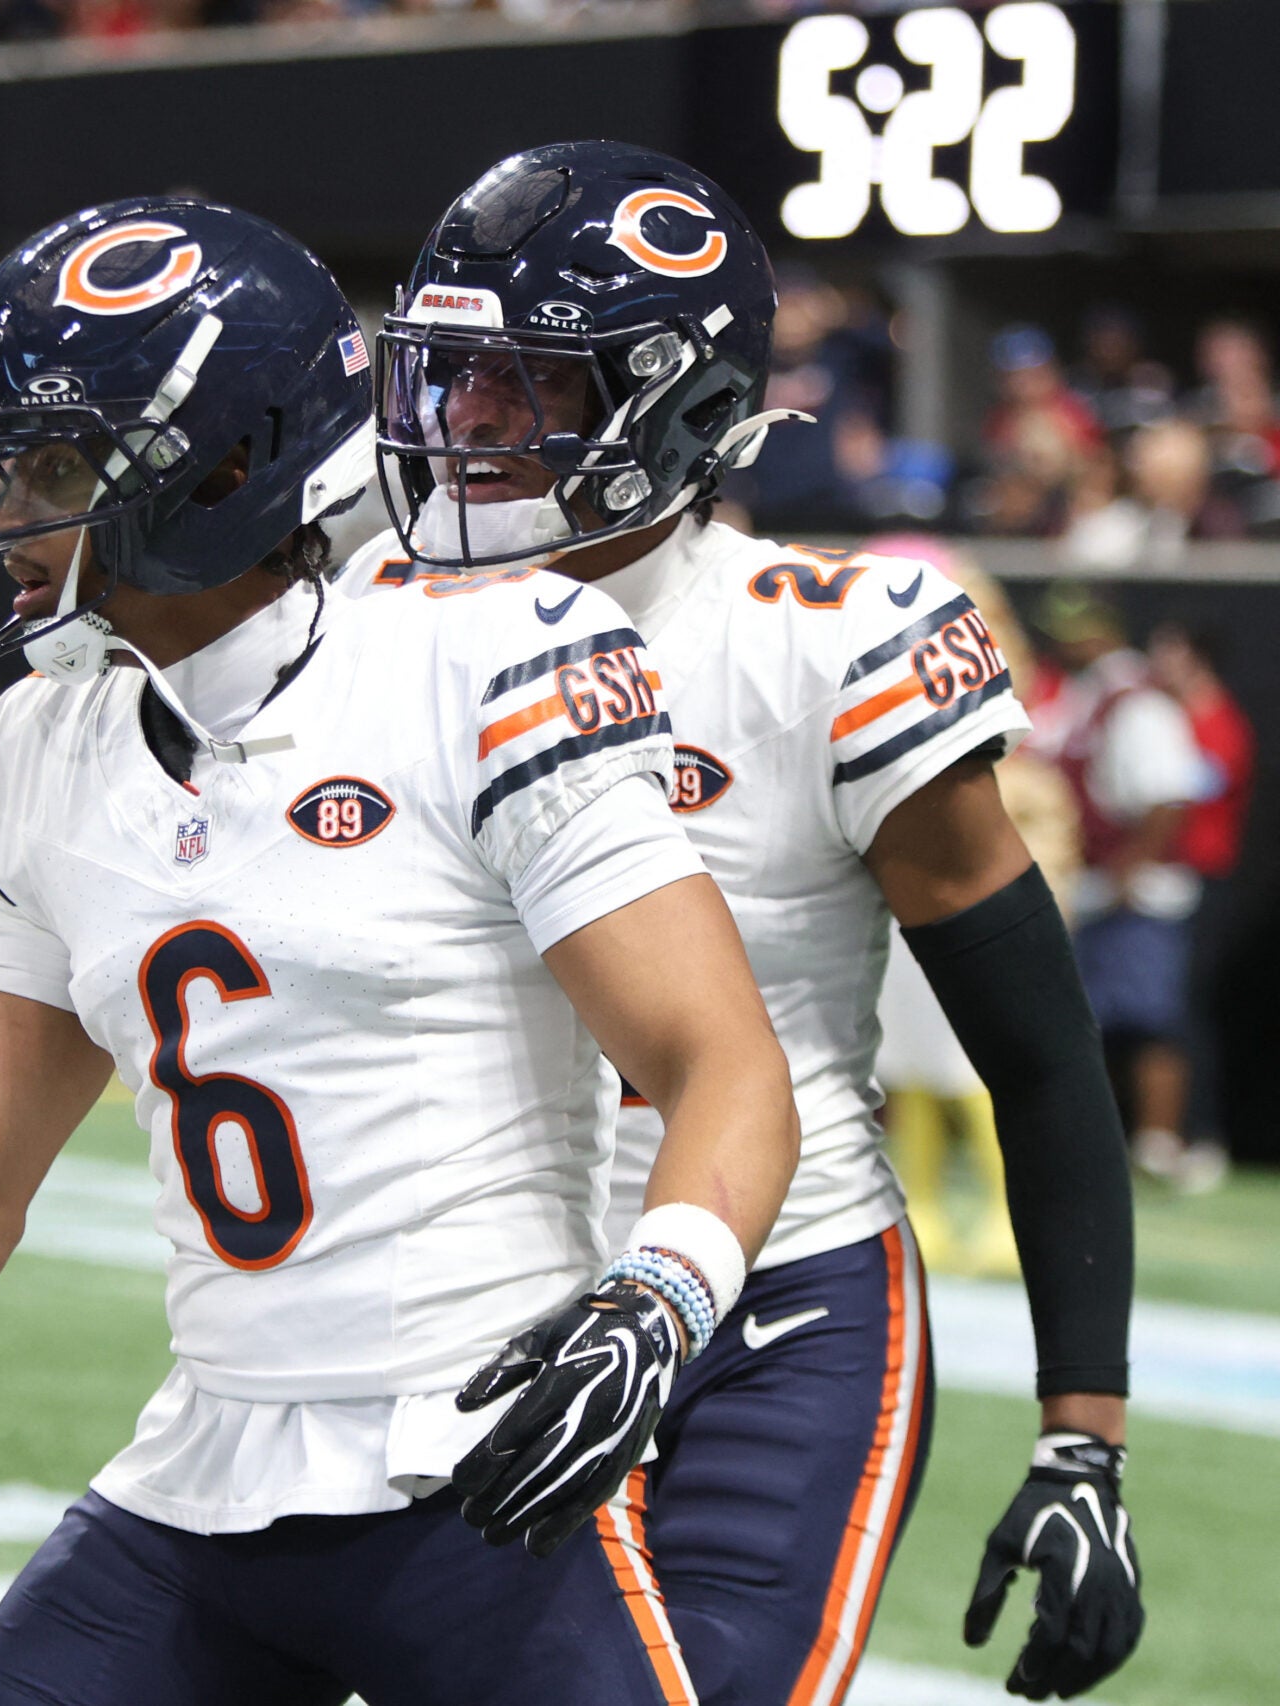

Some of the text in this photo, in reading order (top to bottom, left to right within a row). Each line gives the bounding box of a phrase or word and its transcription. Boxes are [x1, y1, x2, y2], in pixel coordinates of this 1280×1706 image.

[777, 2, 1076, 240] 5:22
[421, 293, 484, 312] BEARS
[529, 314, 591, 333] OAKLEY
[20, 392, 81, 406] OAKLEY
[910, 609, 1002, 710] GSH
[554, 646, 658, 735] GSH
[318, 798, 363, 841] 89
[178, 835, 205, 859] NFL
[138, 919, 314, 1271] 6
